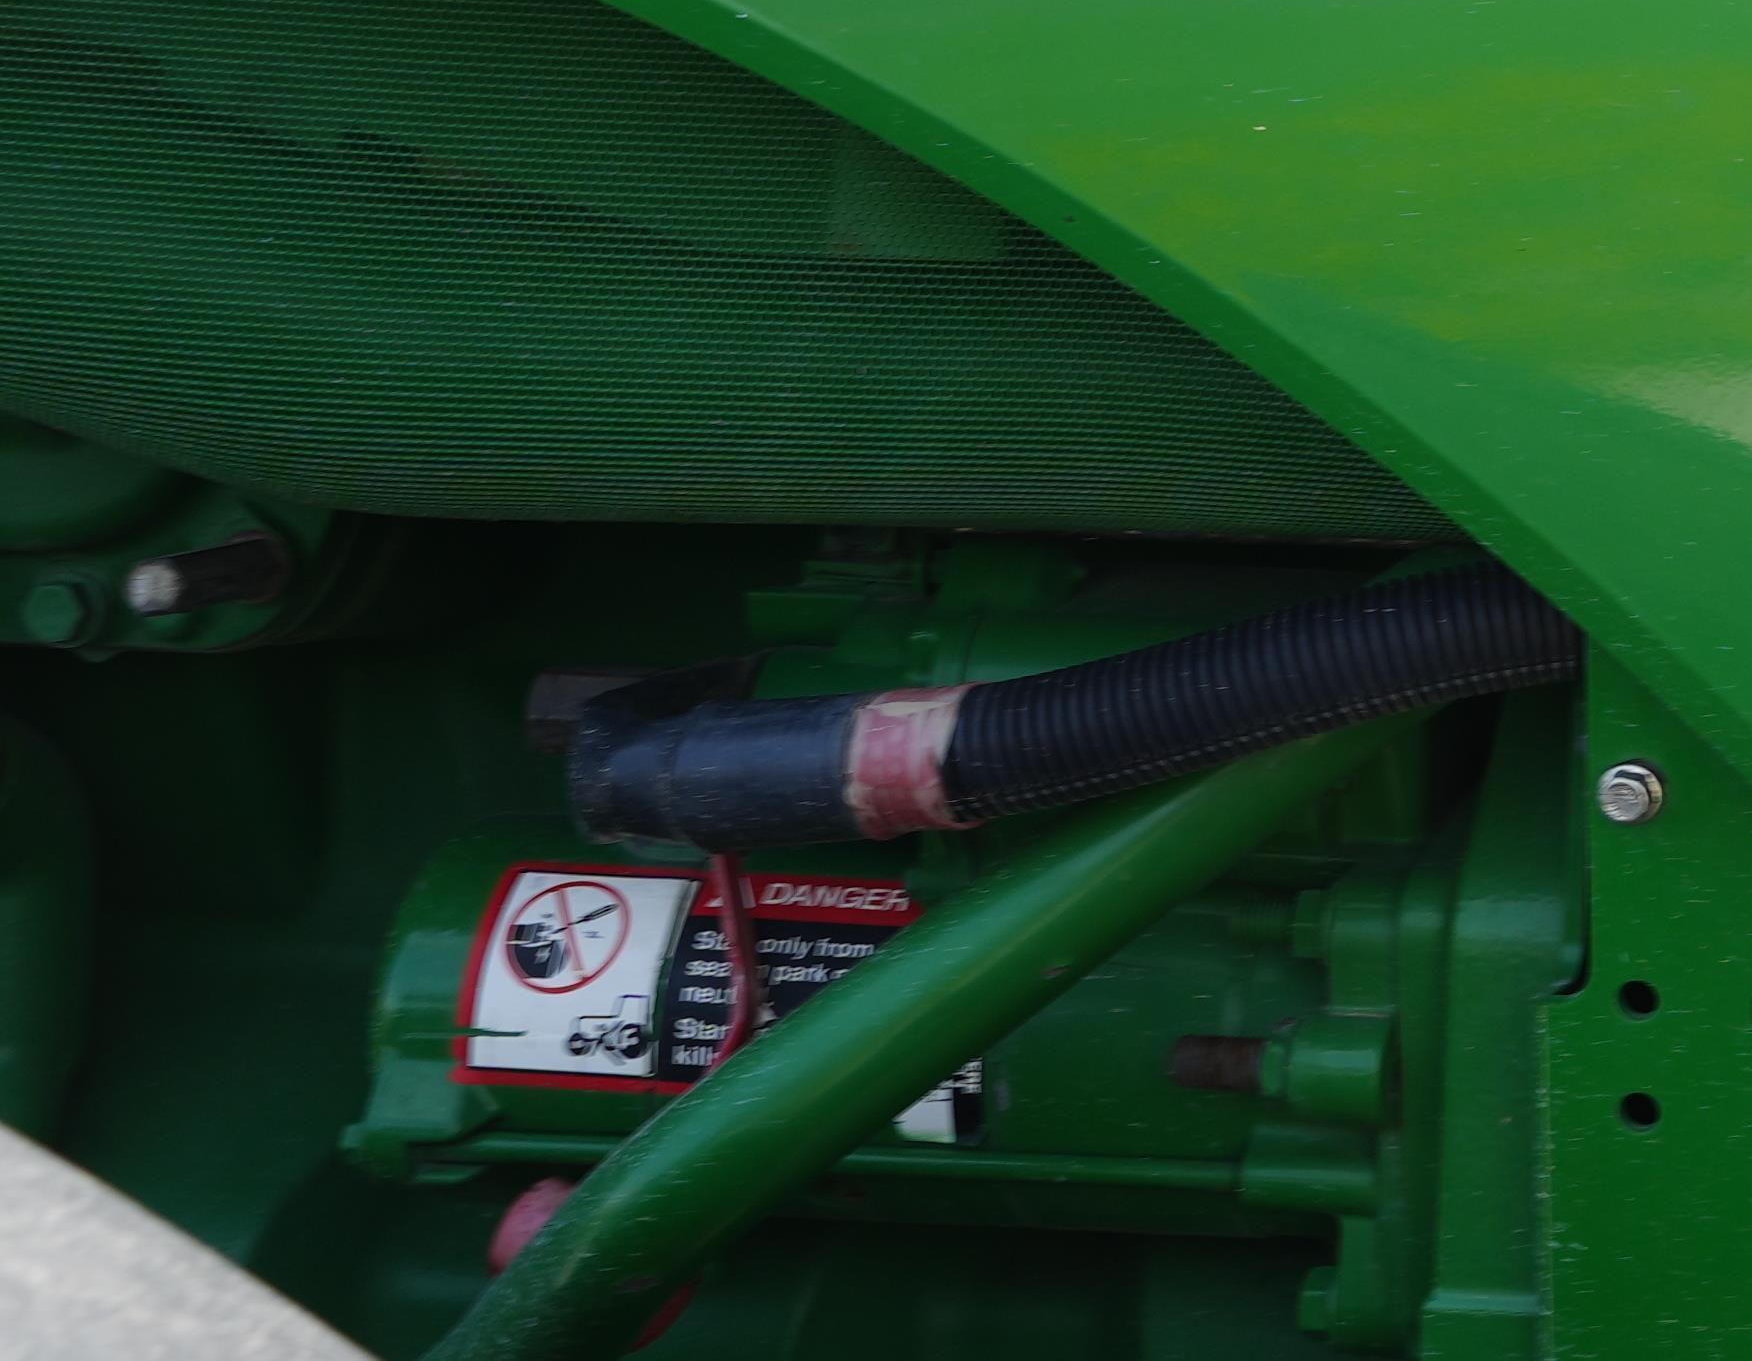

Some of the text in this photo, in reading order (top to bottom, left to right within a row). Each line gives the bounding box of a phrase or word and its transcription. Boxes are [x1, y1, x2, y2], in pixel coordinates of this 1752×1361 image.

[758, 881, 911, 912] DANGER
[755, 935, 814, 960] only
[812, 937, 875, 959] from
[683, 959, 735, 978] sea
[768, 961, 830, 985] park
